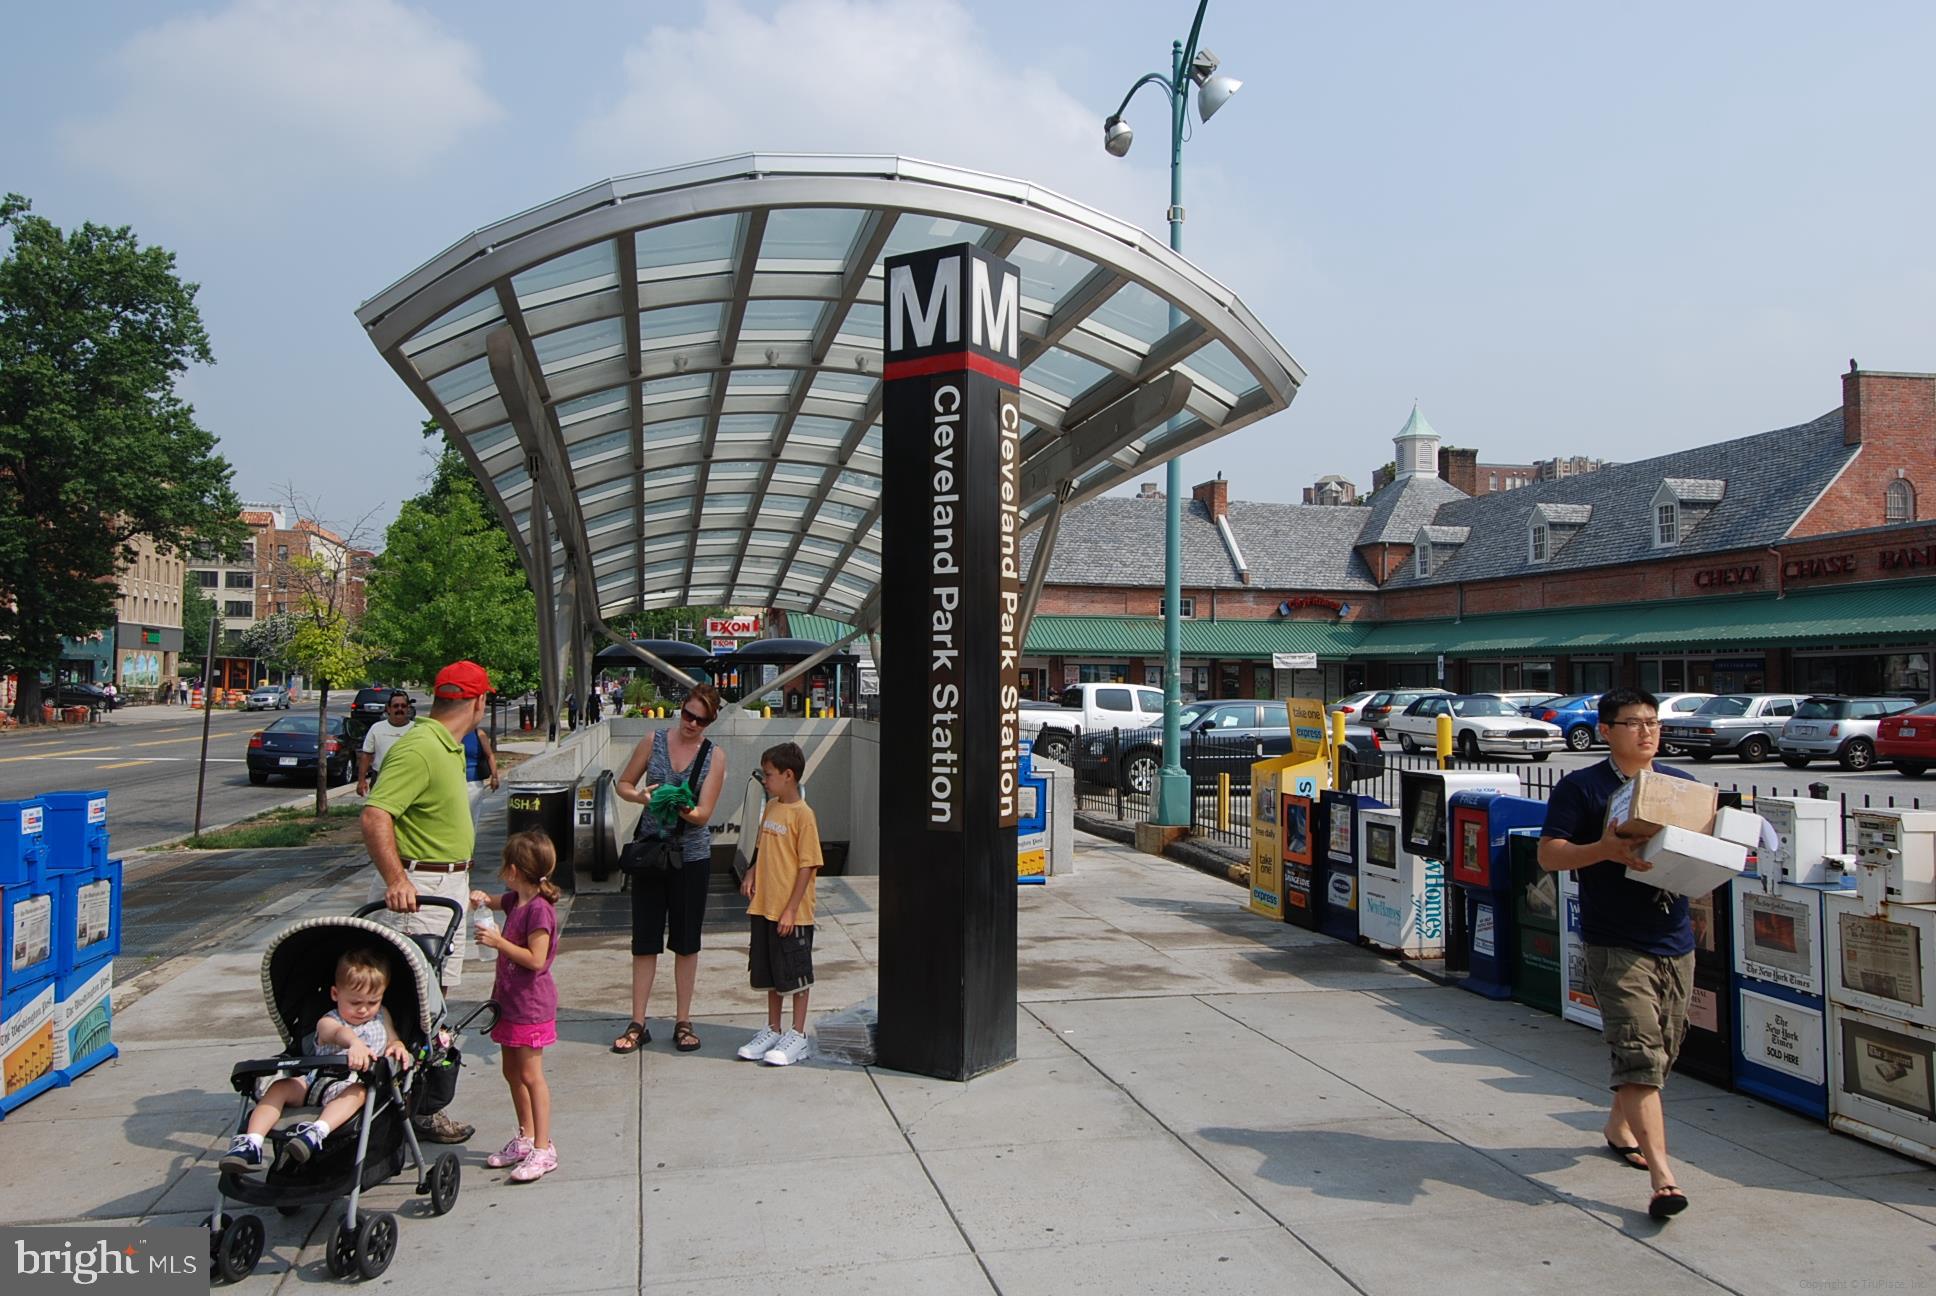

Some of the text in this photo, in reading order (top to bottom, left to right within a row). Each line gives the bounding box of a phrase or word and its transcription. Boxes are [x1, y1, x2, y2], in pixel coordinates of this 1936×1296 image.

[890, 255, 961, 352] M
[972, 256, 1019, 360] M
[1693, 565, 1760, 589] CHEVY
[1784, 556, 1857, 579] CHASE
[931, 384, 961, 823] Cleveland Park Station
[1000, 402, 1019, 818] Cleveland Park Station
[710, 620, 751, 636] EXXON
[713, 639, 734, 648] EXXON
[1293, 706, 1321, 720] take one
[1296, 727, 1322, 740] express
[708, 823, 741, 834] and Pa
[1255, 826, 1276, 840] free daily
[1259, 853, 1273, 866] take
[1260, 864, 1273, 875] one
[1253, 888, 1278, 906] express
[1425, 858, 1447, 940] wHomes
[1745, 963, 1811, 988] The New York Times
[11, 1010, 41, 1037] Washington
[41, 996, 53, 1015] Post
[1775, 1014, 1789, 1027] The
[1765, 1021, 1799, 1042] New York
[1771, 1033, 1794, 1050] Times
[1766, 1046, 1800, 1066] SOLD HERE
